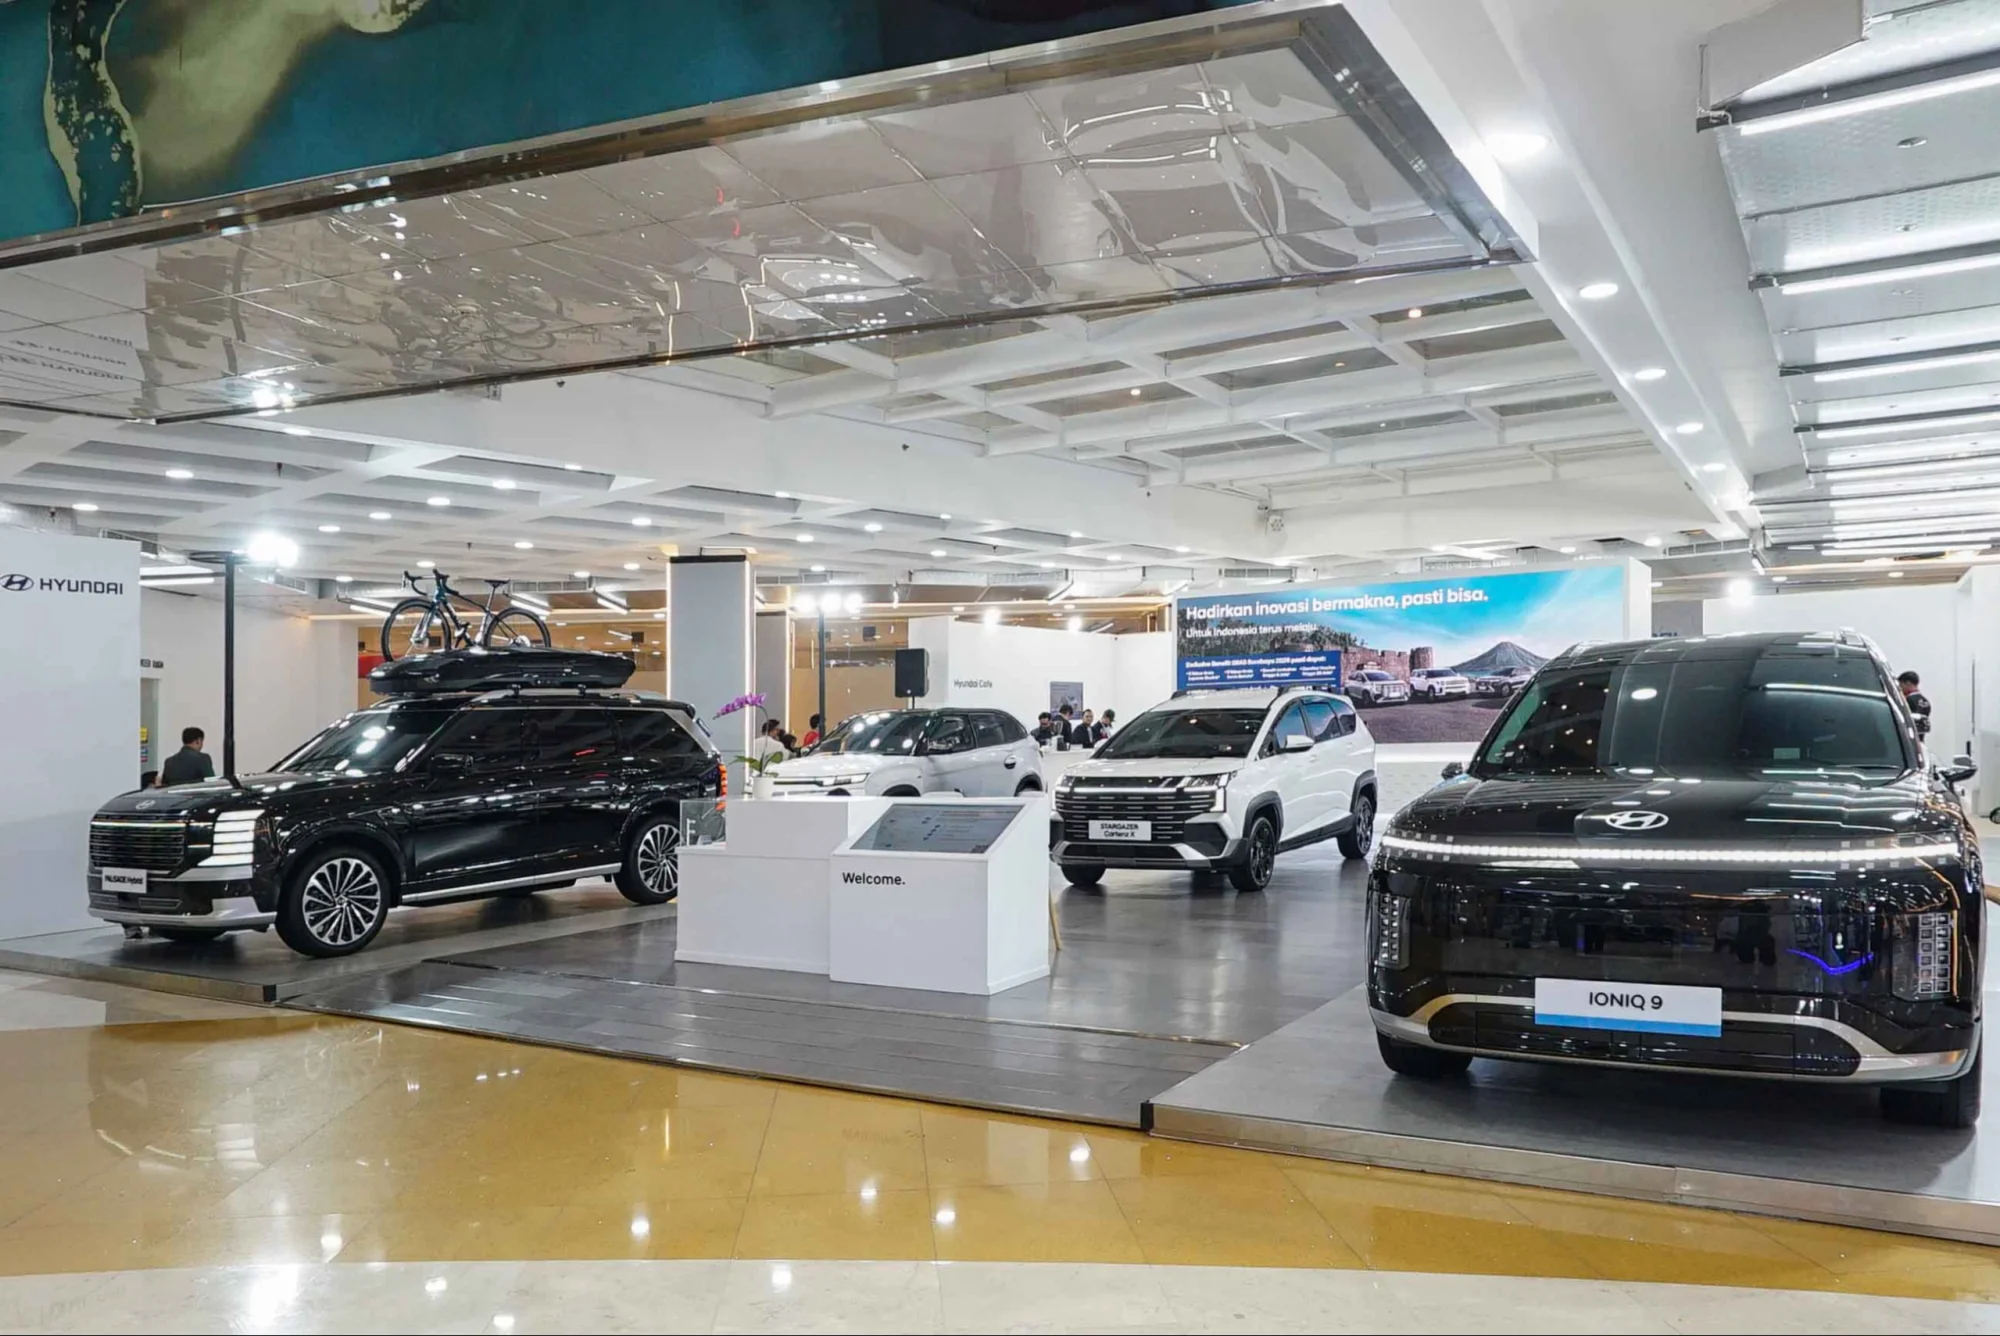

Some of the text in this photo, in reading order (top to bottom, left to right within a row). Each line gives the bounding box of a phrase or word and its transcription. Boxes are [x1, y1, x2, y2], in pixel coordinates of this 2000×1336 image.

[40, 578, 123, 595] HYUNDAI
[1186, 587, 1489, 620] Hadirkan inovasi bermakna, pasti bisa.
[1186, 628, 1212, 638] Untuk
[1213, 625, 1257, 637] Indonesia
[1259, 625, 1282, 634] terus
[954, 679, 978, 689] Hyundai
[842, 872, 906, 885] Welcome.
[1589, 991, 1663, 1011] IONIQ 9
